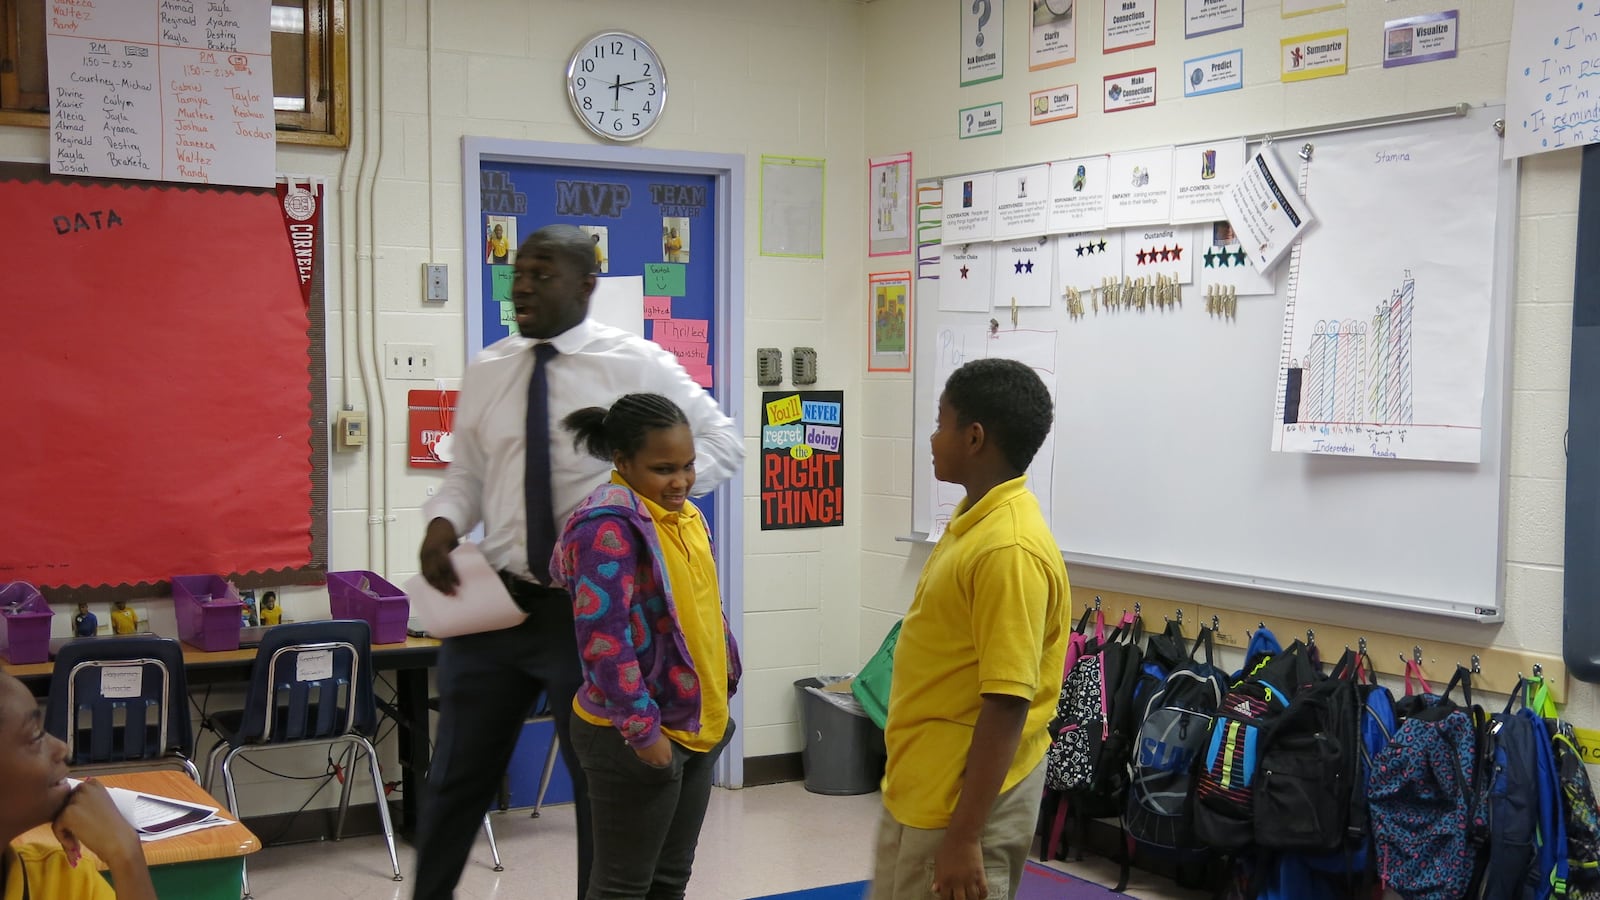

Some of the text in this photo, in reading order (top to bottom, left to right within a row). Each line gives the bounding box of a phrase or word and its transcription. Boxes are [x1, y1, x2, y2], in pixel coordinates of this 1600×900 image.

[161, 1, 194, 14] Ahmad
[52, 17, 78, 32] Randy
[160, 12, 196, 29] Reginald
[206, 18, 240, 28] Ayanna
[1113, 11, 1145, 24] Connections
[163, 30, 189, 45] Kayla
[205, 28, 236, 44] Destiny
[1044, 31, 1060, 42] Clarify
[1416, 24, 1448, 38] Visualize
[1563, 26, 1597, 50] I'm
[595, 45, 604, 58] 11
[611, 41, 624, 55] 12
[633, 48, 637, 60] 1
[1306, 42, 1342, 55] Summarize
[581, 58, 595, 72] 10
[976, 52, 996, 64] Questions
[643, 63, 651, 76] 2
[1212, 59, 1232, 72] Predict
[1539, 58, 1571, 84] I'm
[576, 77, 586, 90] 9
[1131, 76, 1144, 86] Make
[56, 87, 86, 100] Divine
[648, 82, 656, 96] 3
[1122, 86, 1152, 98] Connections
[1556, 84, 1589, 106] I'm
[223, 86, 261, 107] Taylor
[583, 96, 592, 110] 8
[1054, 94, 1069, 104] Clarify
[642, 100, 652, 114] 4
[103, 108, 129, 123] Jayla
[596, 111, 604, 124] 7
[632, 113, 640, 126] 5
[1530, 109, 1546, 133] It
[55, 120, 84, 132] Ahmad
[103, 122, 137, 137] Ayanna
[175, 119, 208, 132] Joshua
[232, 121, 273, 140] Jordan
[614, 118, 623, 131] 6
[978, 119, 996, 128] Questions
[55, 132, 93, 148] Reginald
[104, 135, 141, 157] Destiny
[57, 149, 85, 165] Kayla
[1376, 150, 1410, 164] Stamina
[57, 160, 89, 173] Josiah
[177, 166, 209, 183] Randy
[555, 180, 631, 218] MVP
[649, 182, 707, 206] TEAM
[660, 206, 700, 218] PLAYER
[53, 209, 123, 236] DATA
[289, 223, 314, 284] CORNELL
[656, 321, 706, 339] Thrilled
[770, 398, 838, 424] You'll NEVER
[765, 427, 839, 450] regret doing
[796, 446, 809, 458] the
[1312, 440, 1397, 458] Independent Reading
[765, 454, 841, 490] RIGHT
[762, 488, 842, 525] THING!
